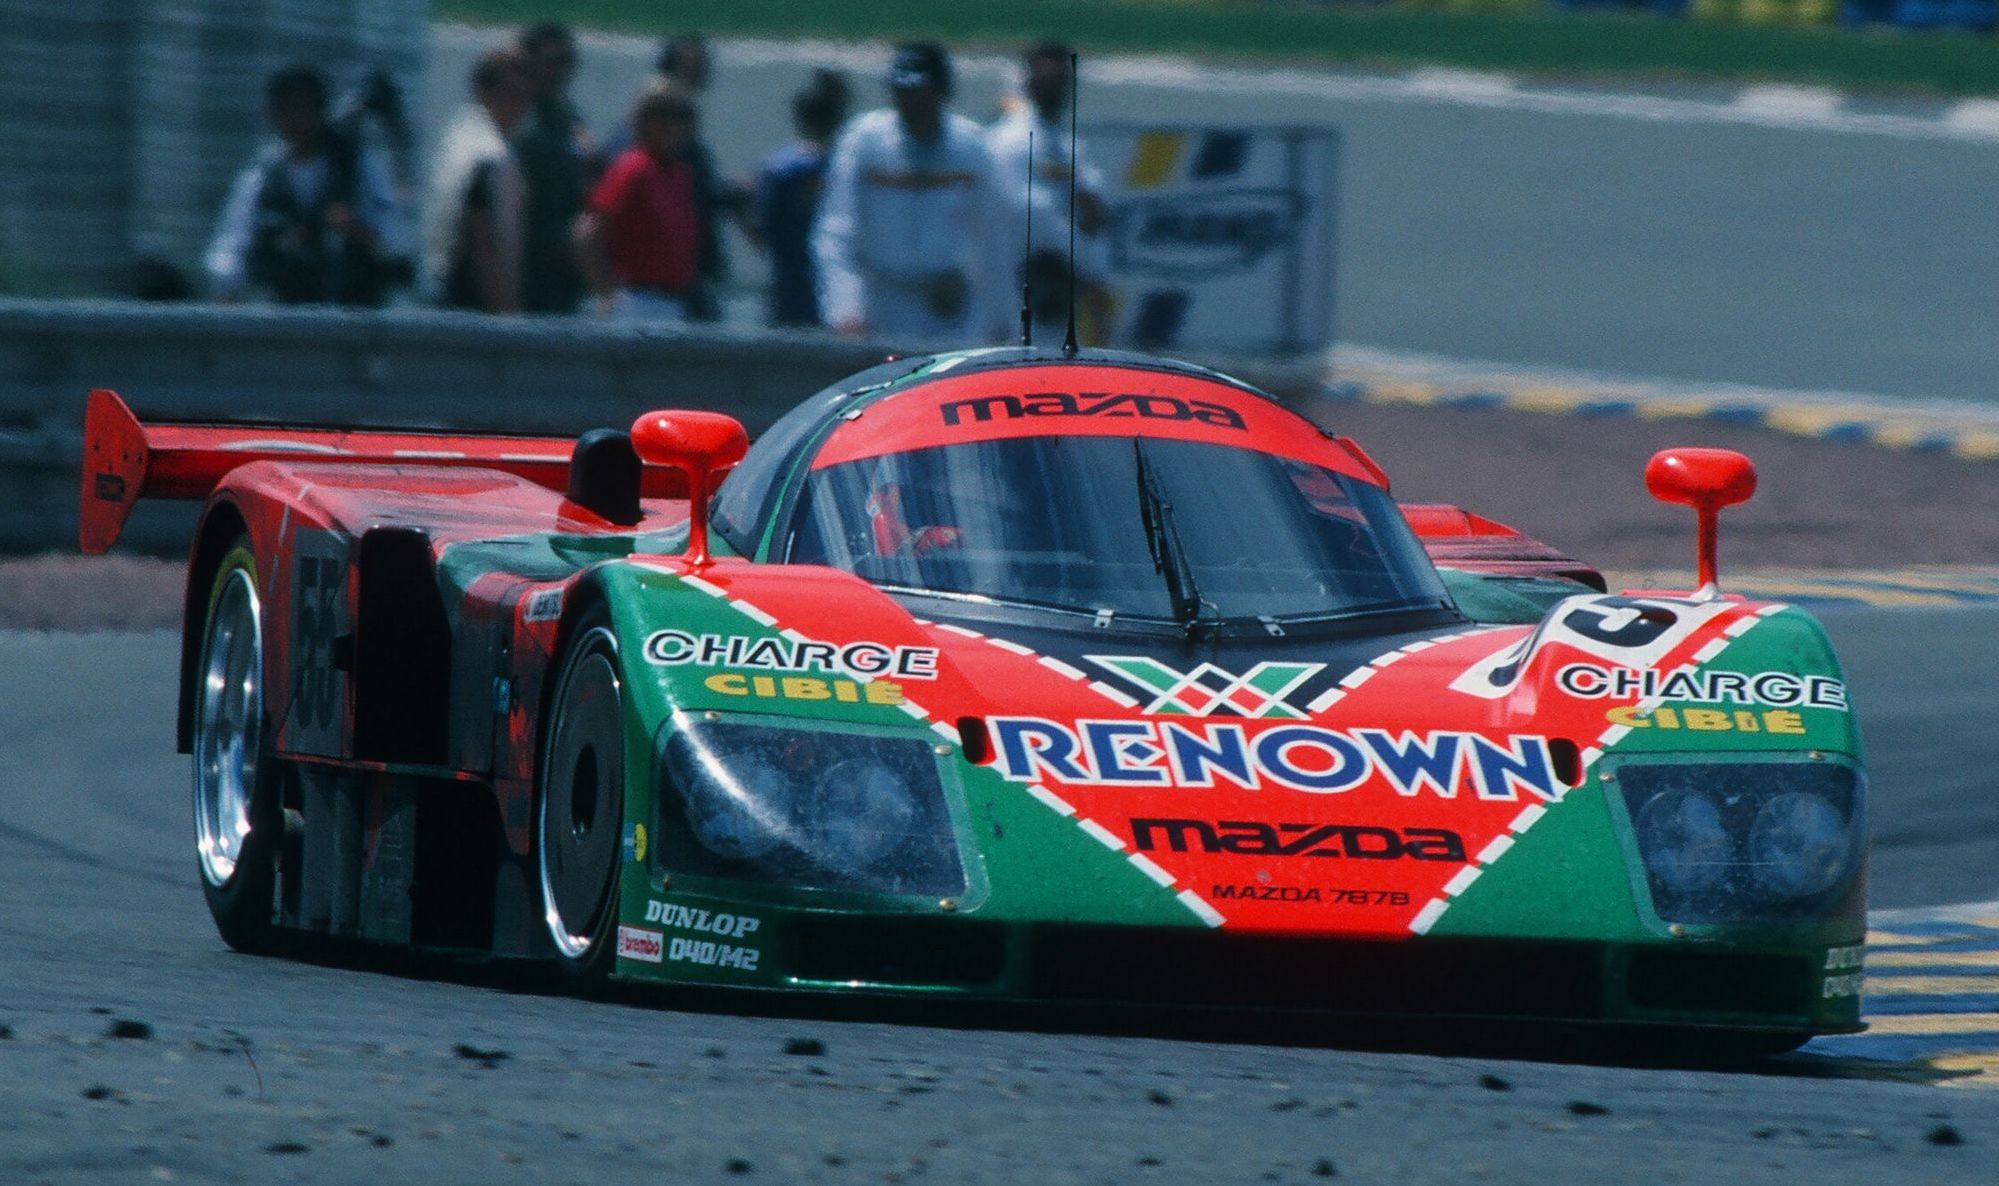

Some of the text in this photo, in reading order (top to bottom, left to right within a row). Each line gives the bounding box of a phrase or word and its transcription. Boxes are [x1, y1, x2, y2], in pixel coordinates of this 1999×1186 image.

[643, 629, 940, 681] CHARGE
[1555, 662, 1849, 712] CHARGE
[985, 716, 1565, 802] RENOWN
[644, 899, 761, 938] DUNLOP
[1212, 884, 1410, 906] MAZDA 787B
